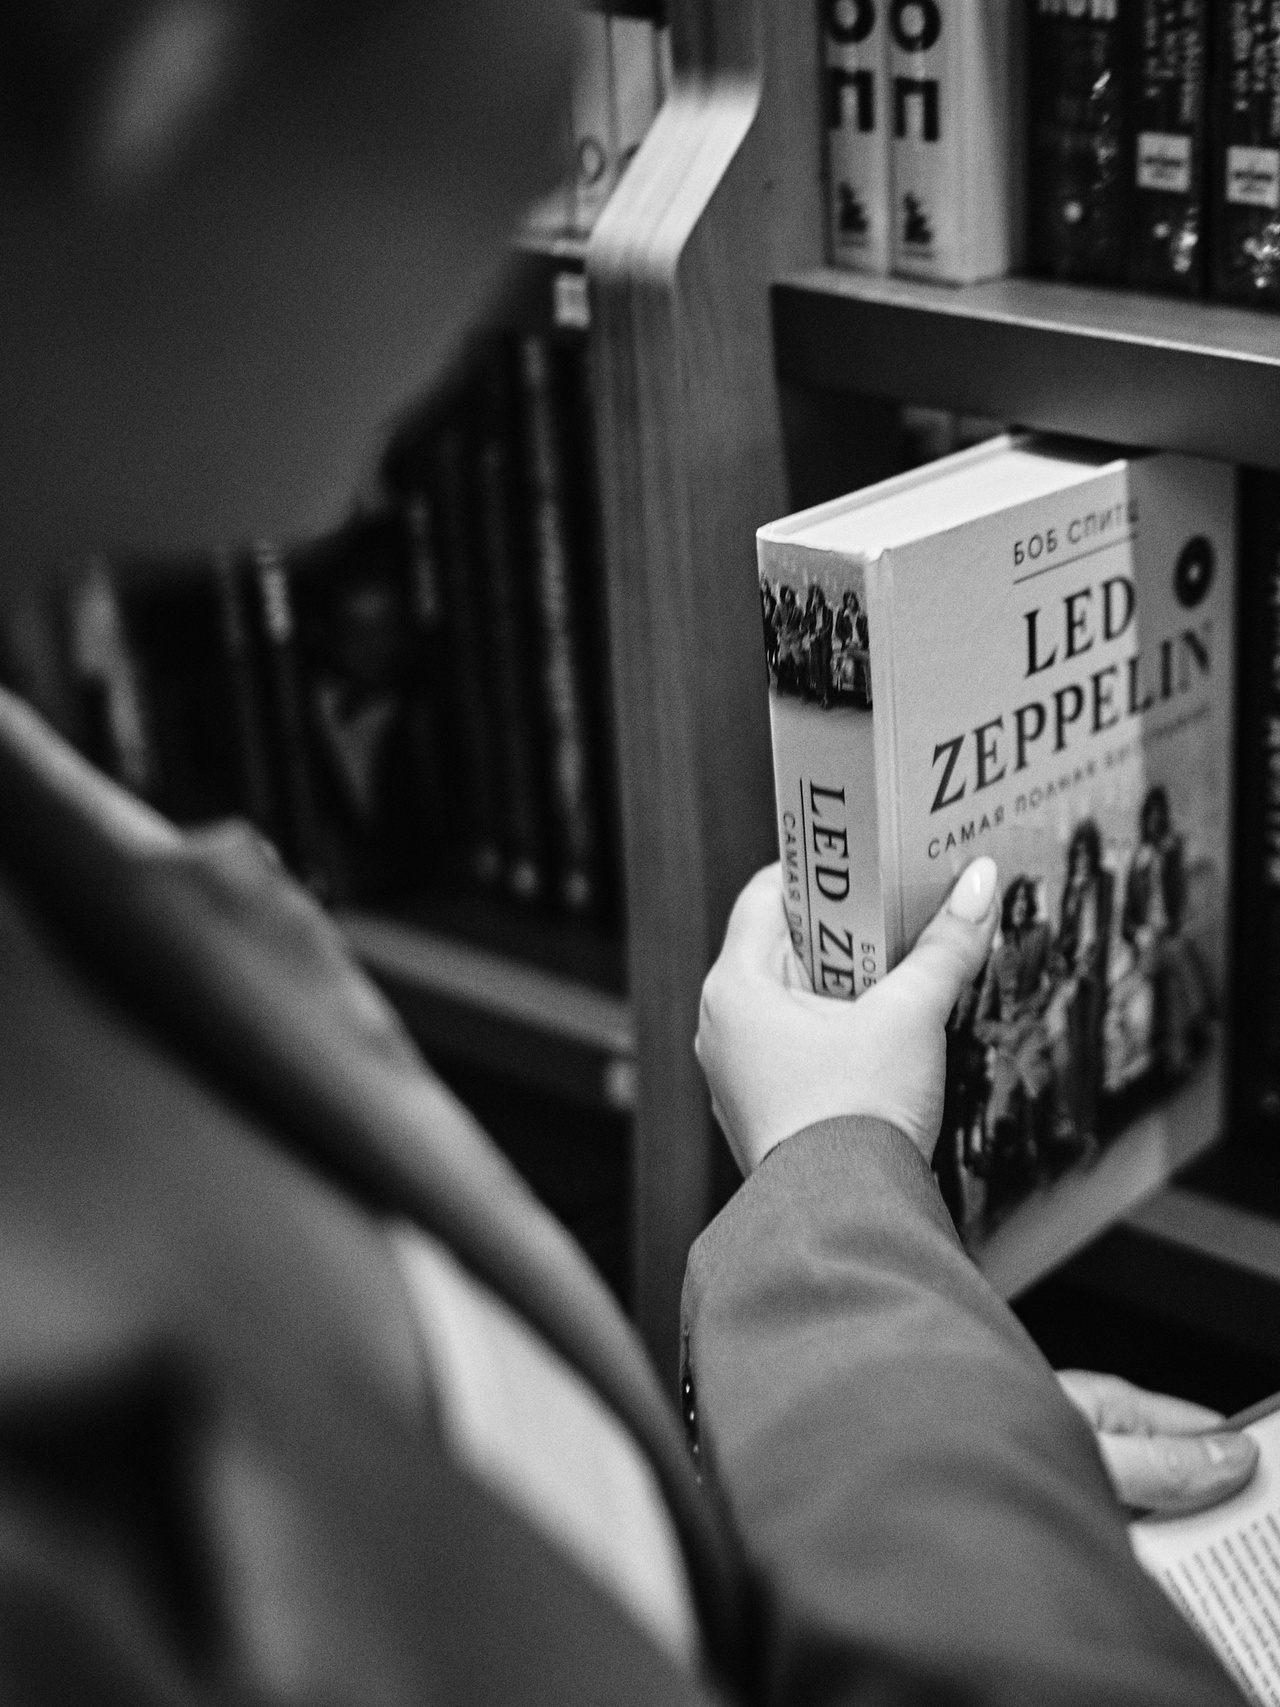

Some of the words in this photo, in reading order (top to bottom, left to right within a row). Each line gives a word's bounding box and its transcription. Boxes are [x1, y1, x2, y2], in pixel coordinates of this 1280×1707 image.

[1012, 527, 1058, 567] БОБ
[1023, 575, 1136, 680] LED
[930, 618, 1213, 816] ZEPPELIN
[809, 779, 851, 902] LED
[927, 804, 1005, 861] САМАЯ
